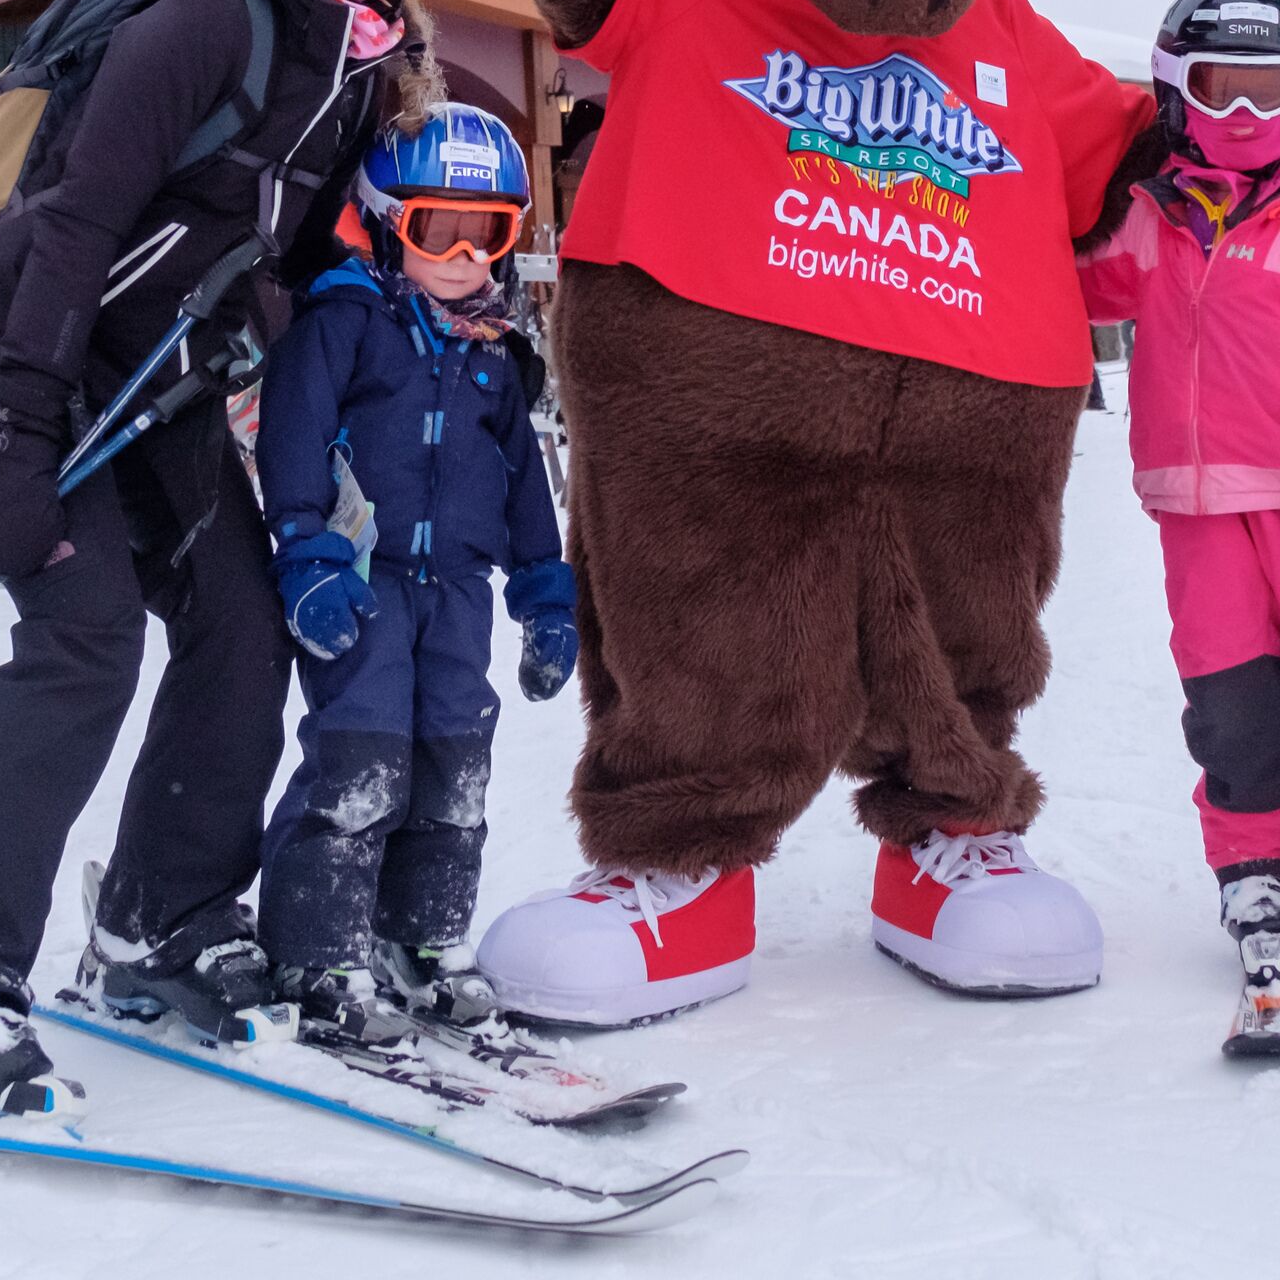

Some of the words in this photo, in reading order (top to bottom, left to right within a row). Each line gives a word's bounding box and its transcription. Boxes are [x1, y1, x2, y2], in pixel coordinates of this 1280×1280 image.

[1228, 24, 1269, 37] SMITH
[450, 166, 492, 180] GIRO
[787, 157, 841, 185] IT'S
[849, 165, 898, 199] THE
[908, 175, 970, 228] SNOW
[800, 133, 840, 156] SKI
[858, 150, 961, 189] RESORT
[773, 188, 982, 278] CANADA
[768, 235, 984, 316] bigwhite.com
